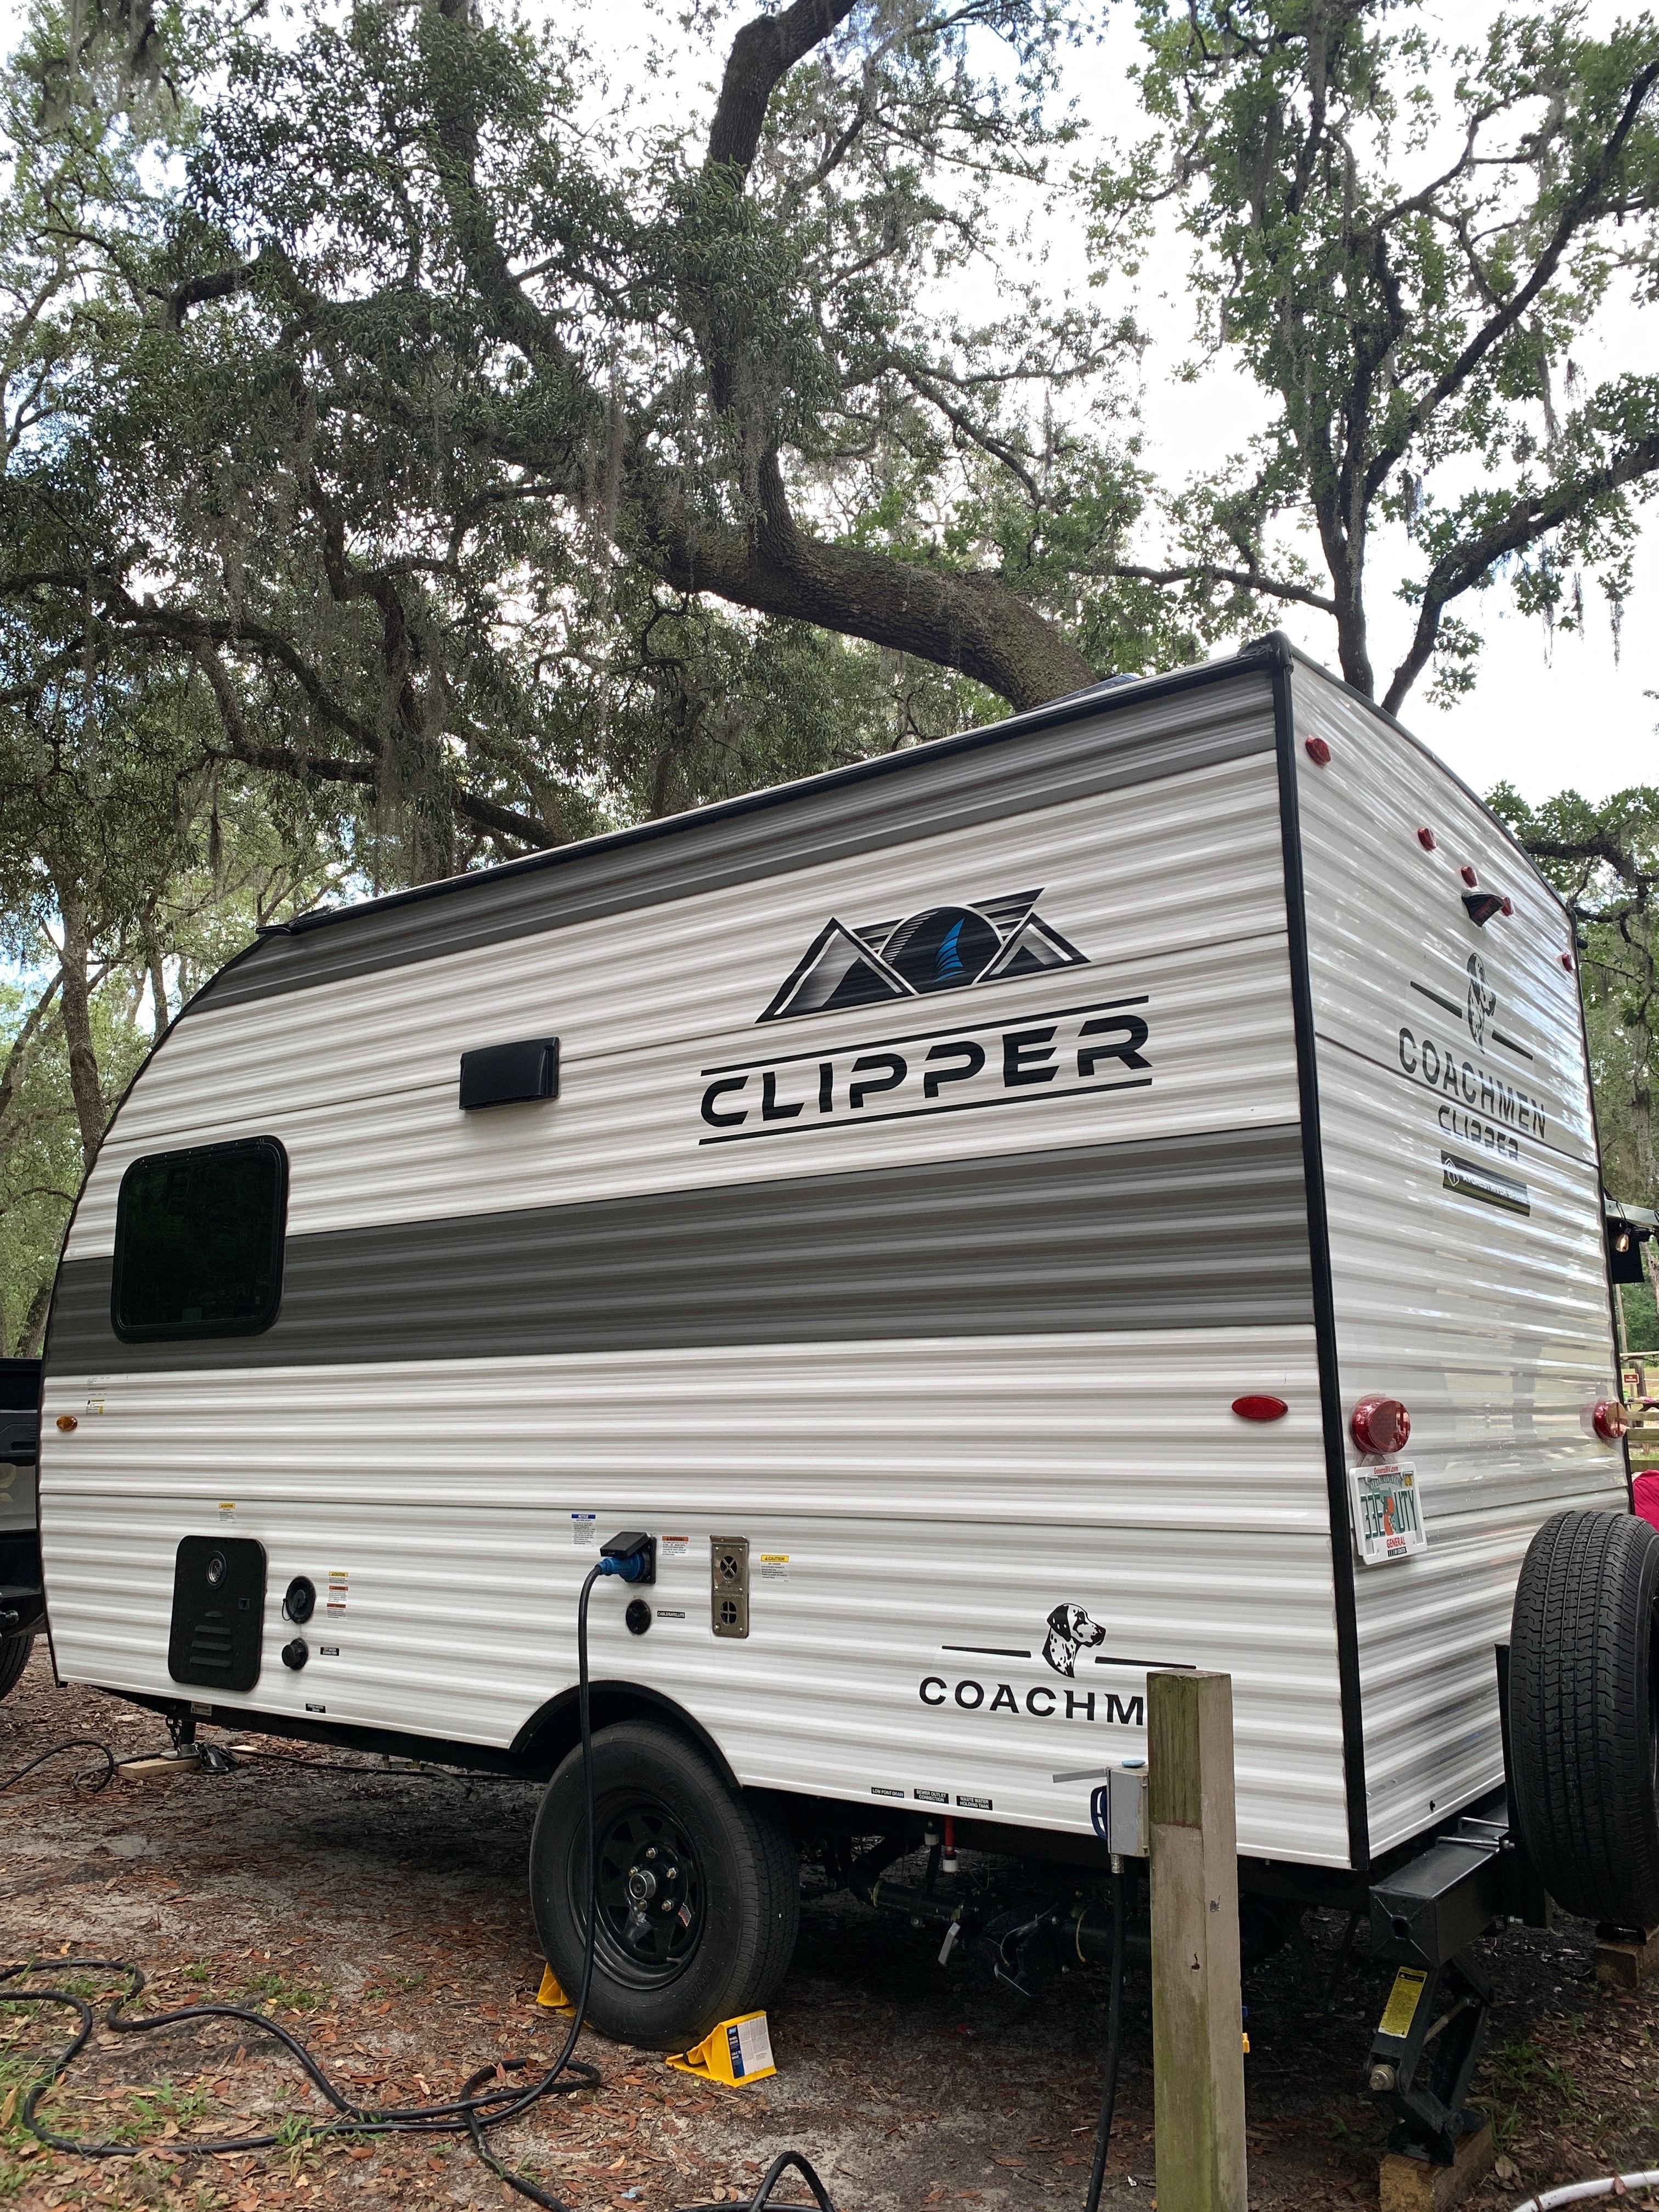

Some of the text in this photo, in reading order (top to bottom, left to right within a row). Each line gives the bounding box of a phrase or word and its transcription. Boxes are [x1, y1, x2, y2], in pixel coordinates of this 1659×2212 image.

[701, 1014, 1153, 1127] CLIPPER
[1399, 1028, 1545, 1139] COACHMEN
[1438, 1104, 1518, 1161] CLIPPER
[1387, 1536, 1406, 1548] GENERAL
[919, 1676, 1143, 1726] COACHM
